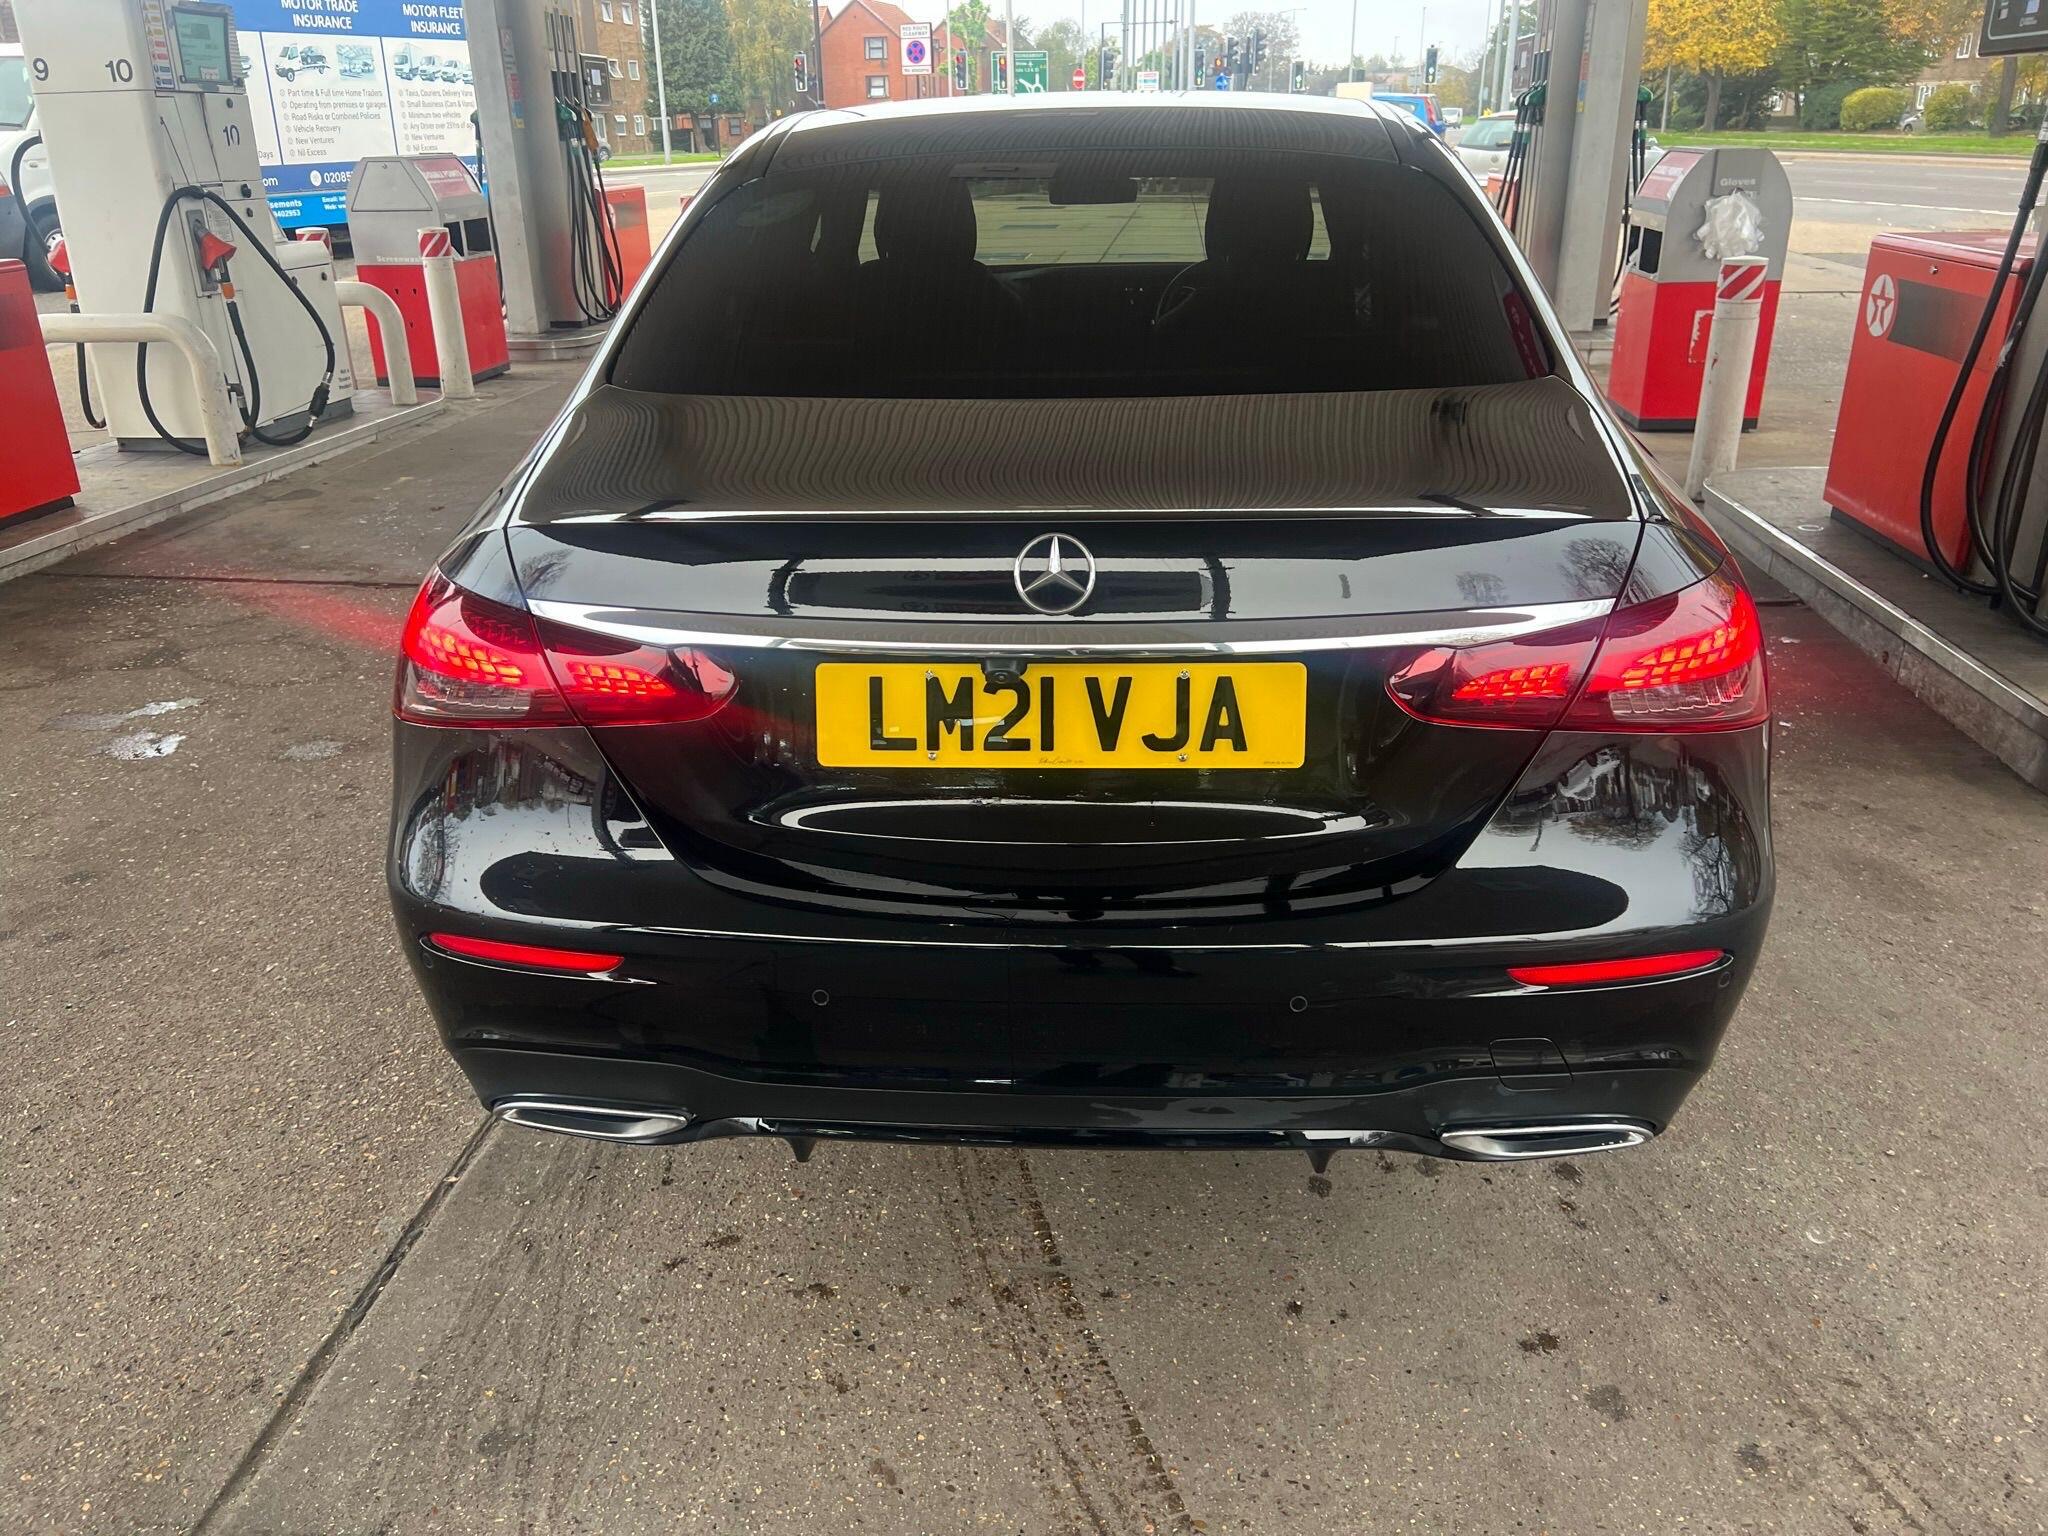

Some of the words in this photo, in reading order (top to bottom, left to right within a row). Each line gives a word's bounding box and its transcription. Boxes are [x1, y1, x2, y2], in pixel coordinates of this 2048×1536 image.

[280, 0, 323, 10] MOTOR
[325, 0, 359, 13] TRADE
[402, 4, 438, 18] MOTOR
[439, 6, 464, 19] FLEET
[292, 14, 353, 30] INSURANCE
[410, 20, 461, 35] INSURANCE
[32, 57, 49, 81] 9
[105, 58, 134, 82] 10
[287, 89, 301, 97] Part
[301, 89, 314, 97] time
[320, 89, 332, 97] Full
[332, 89, 344, 97] time
[345, 89, 361, 97] Home
[362, 89, 383, 97] Traders
[289, 101, 318, 110] Operating
[333, 102, 358, 110] premises
[360, 112, 381, 120] Policies
[223, 124, 240, 146] 10
[293, 125, 315, 133] Vehicle
[315, 124, 341, 134] Recovery
[1720, 177, 1756, 187] Gloves
[868, 675, 1054, 752] LM21
[1084, 675, 1249, 753] VJA
